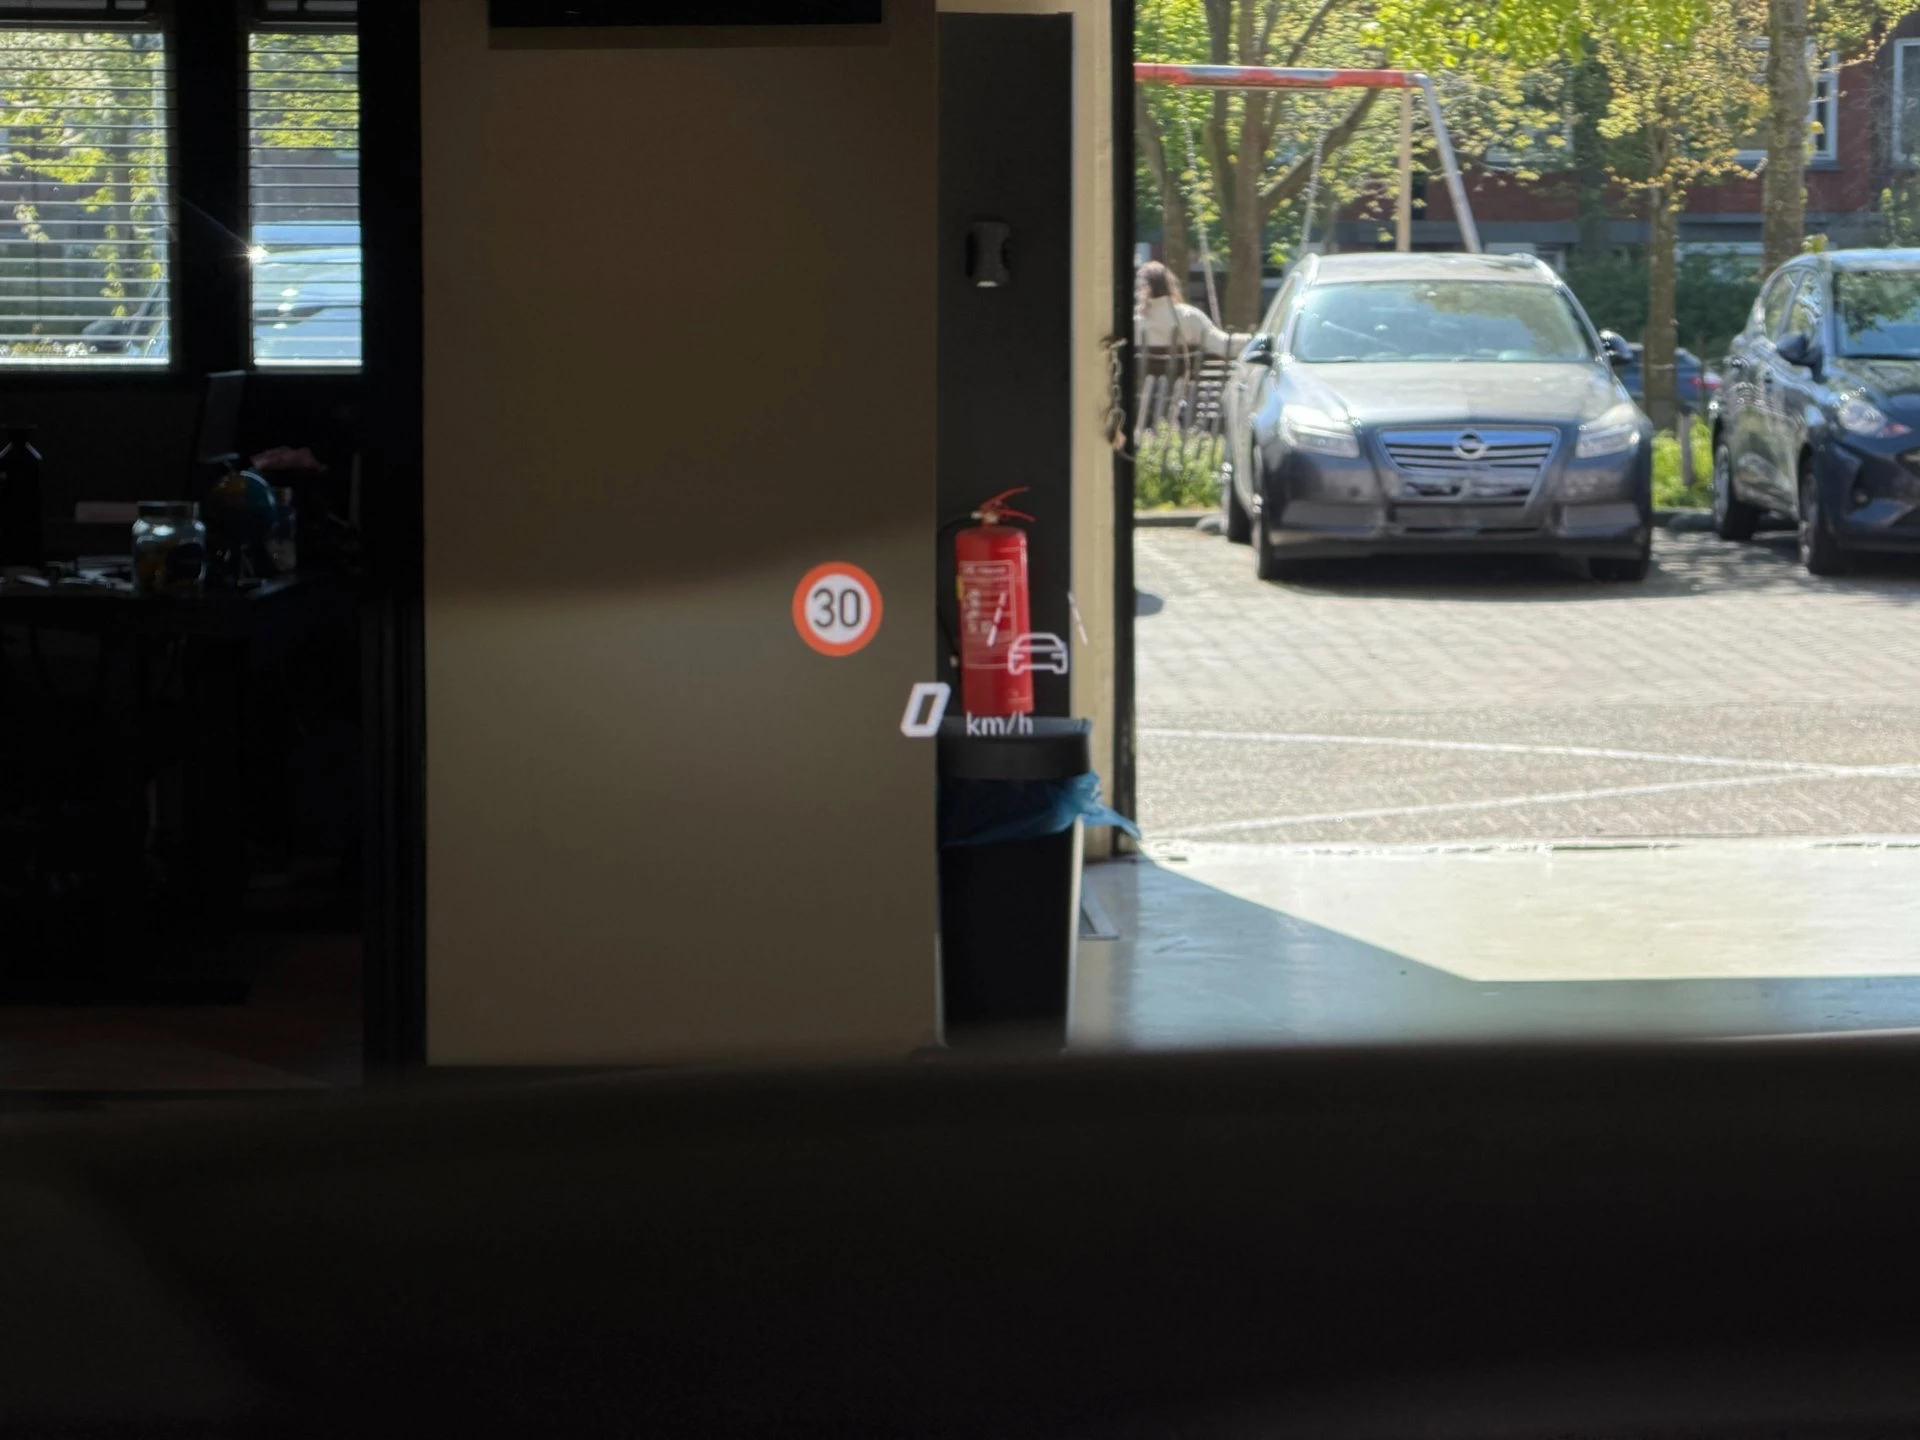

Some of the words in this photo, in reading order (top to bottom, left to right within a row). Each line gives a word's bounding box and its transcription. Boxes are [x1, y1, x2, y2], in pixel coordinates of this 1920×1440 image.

[812, 588, 862, 628] 30
[900, 682, 951, 737] 0
[966, 711, 1034, 736] km/h
